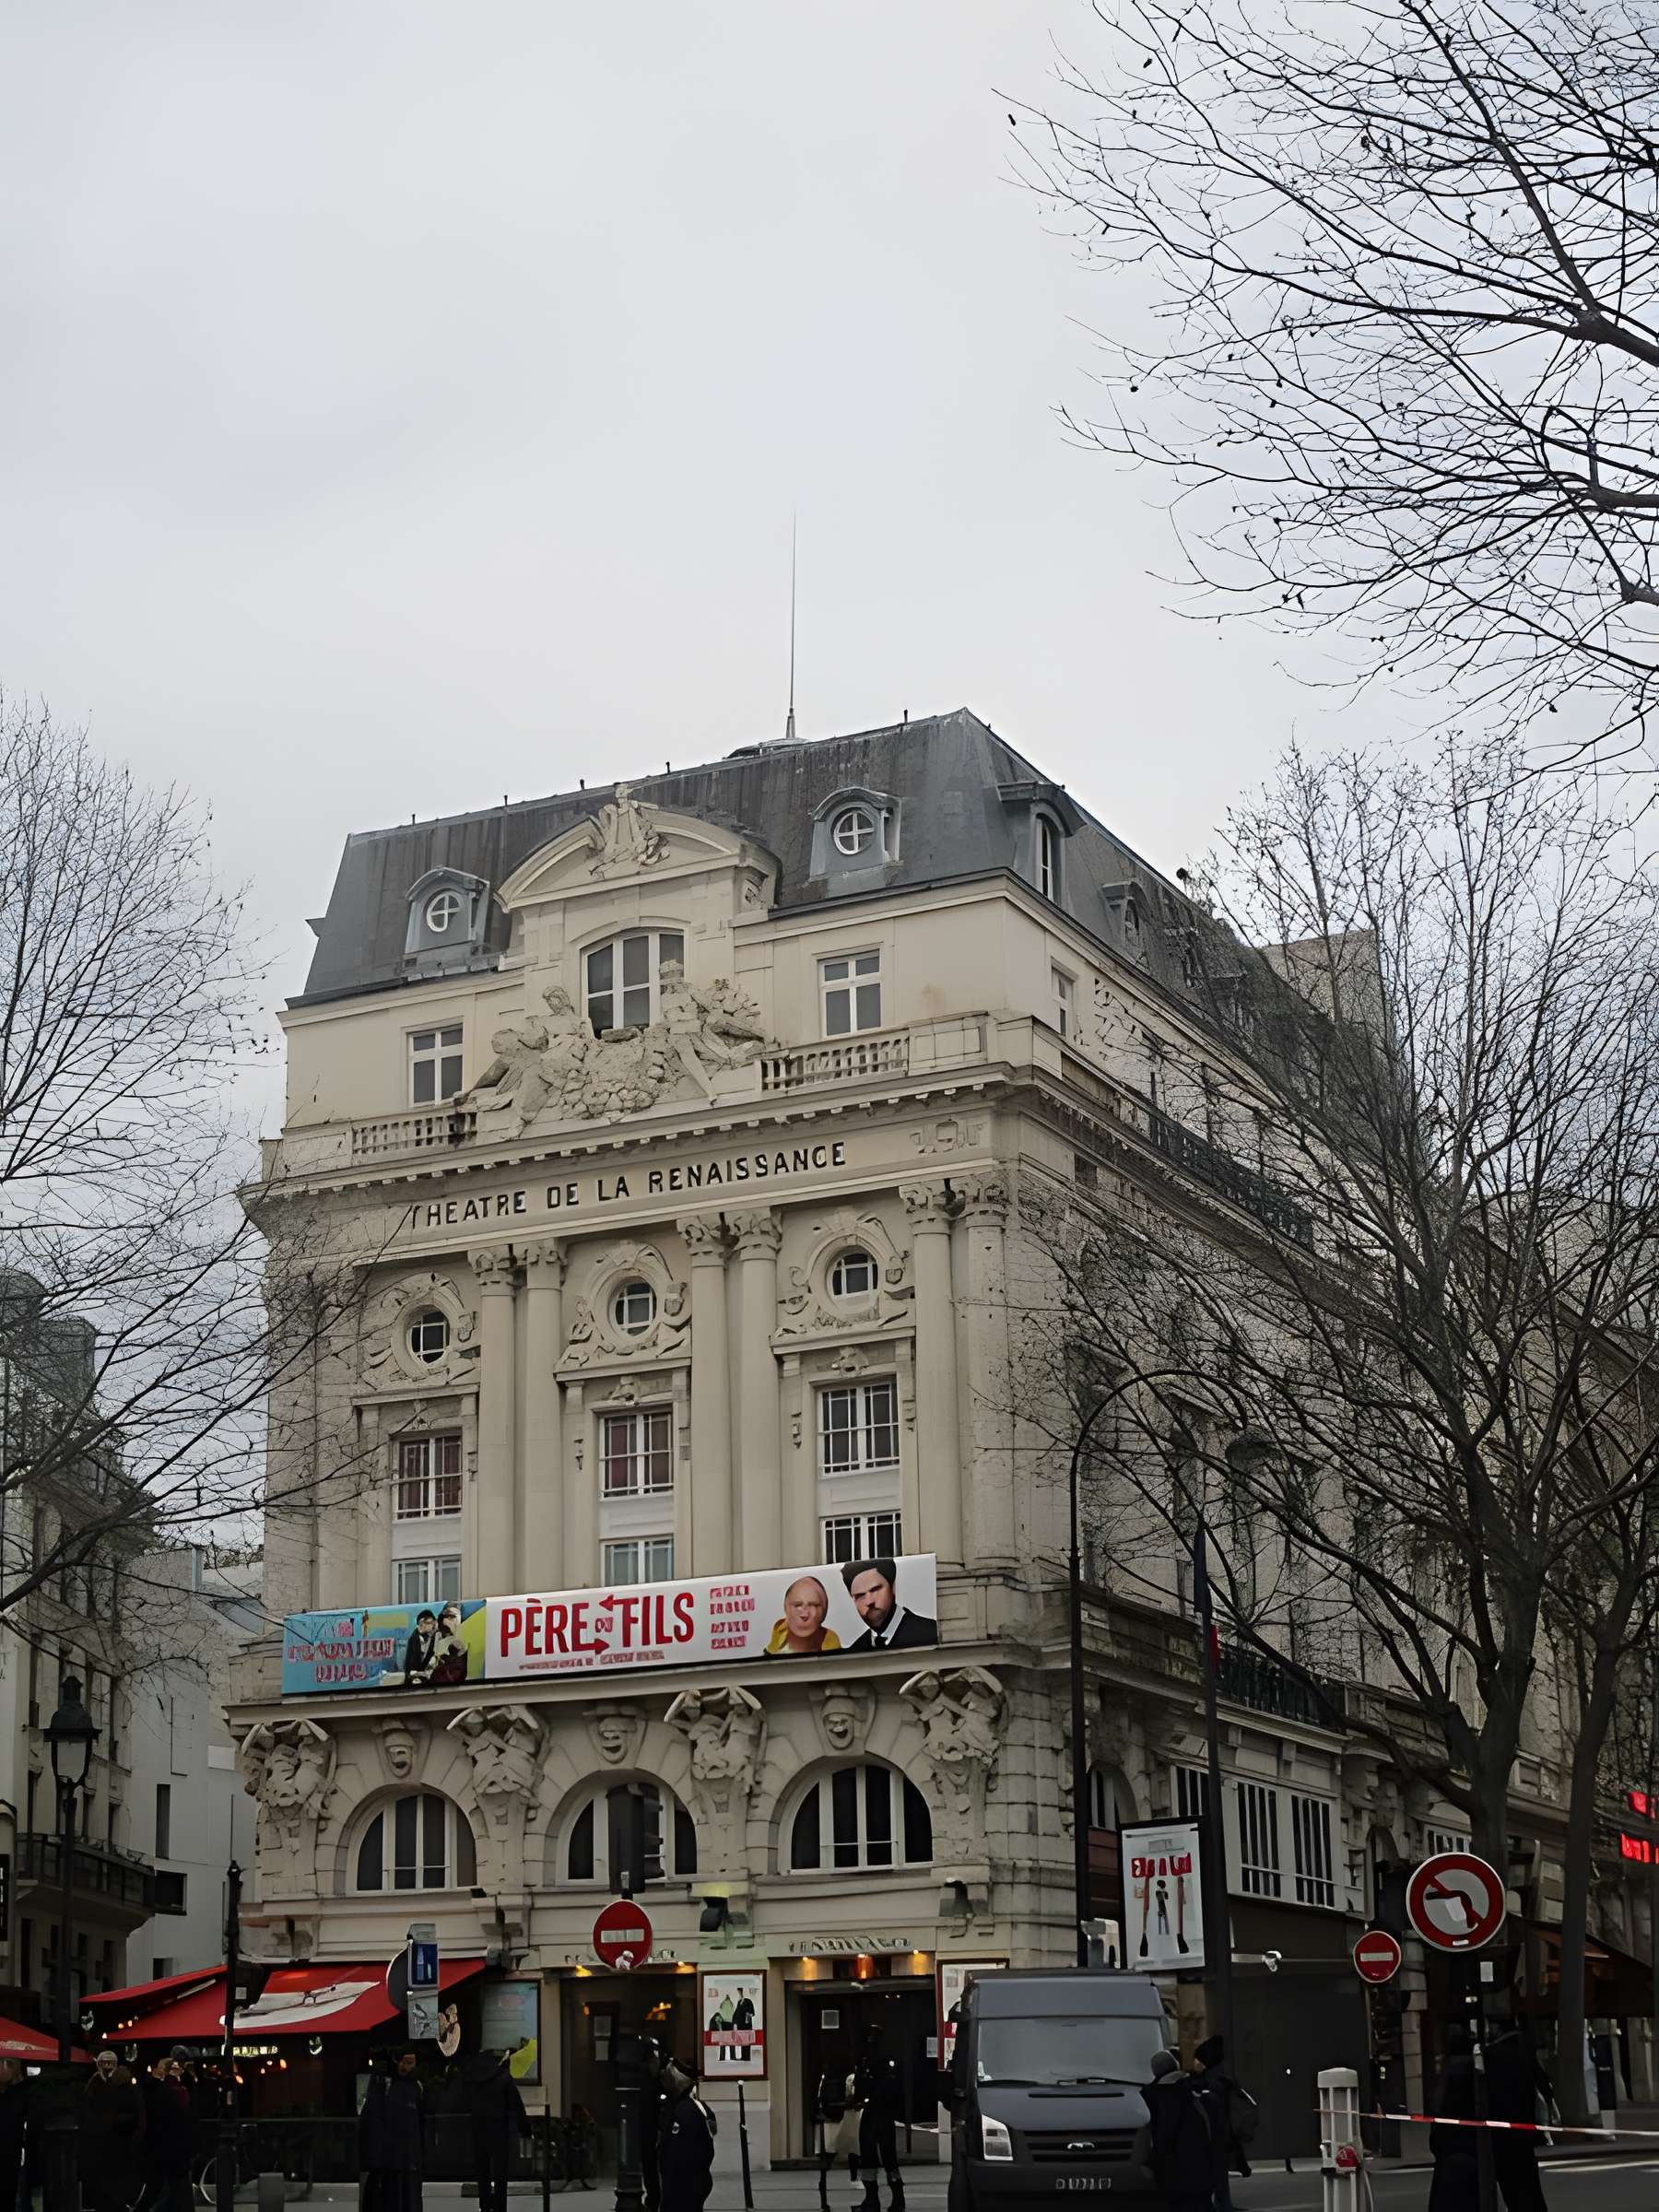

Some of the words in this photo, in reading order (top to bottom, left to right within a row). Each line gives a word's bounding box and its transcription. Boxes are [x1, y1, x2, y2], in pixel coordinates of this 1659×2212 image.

[547, 1182, 580, 1210] DE
[597, 1175, 630, 1202] LA
[648, 1141, 846, 1194] RENAISSANCE
[500, 1597, 591, 1658] PÈRE
[616, 1592, 695, 1648] FILS
